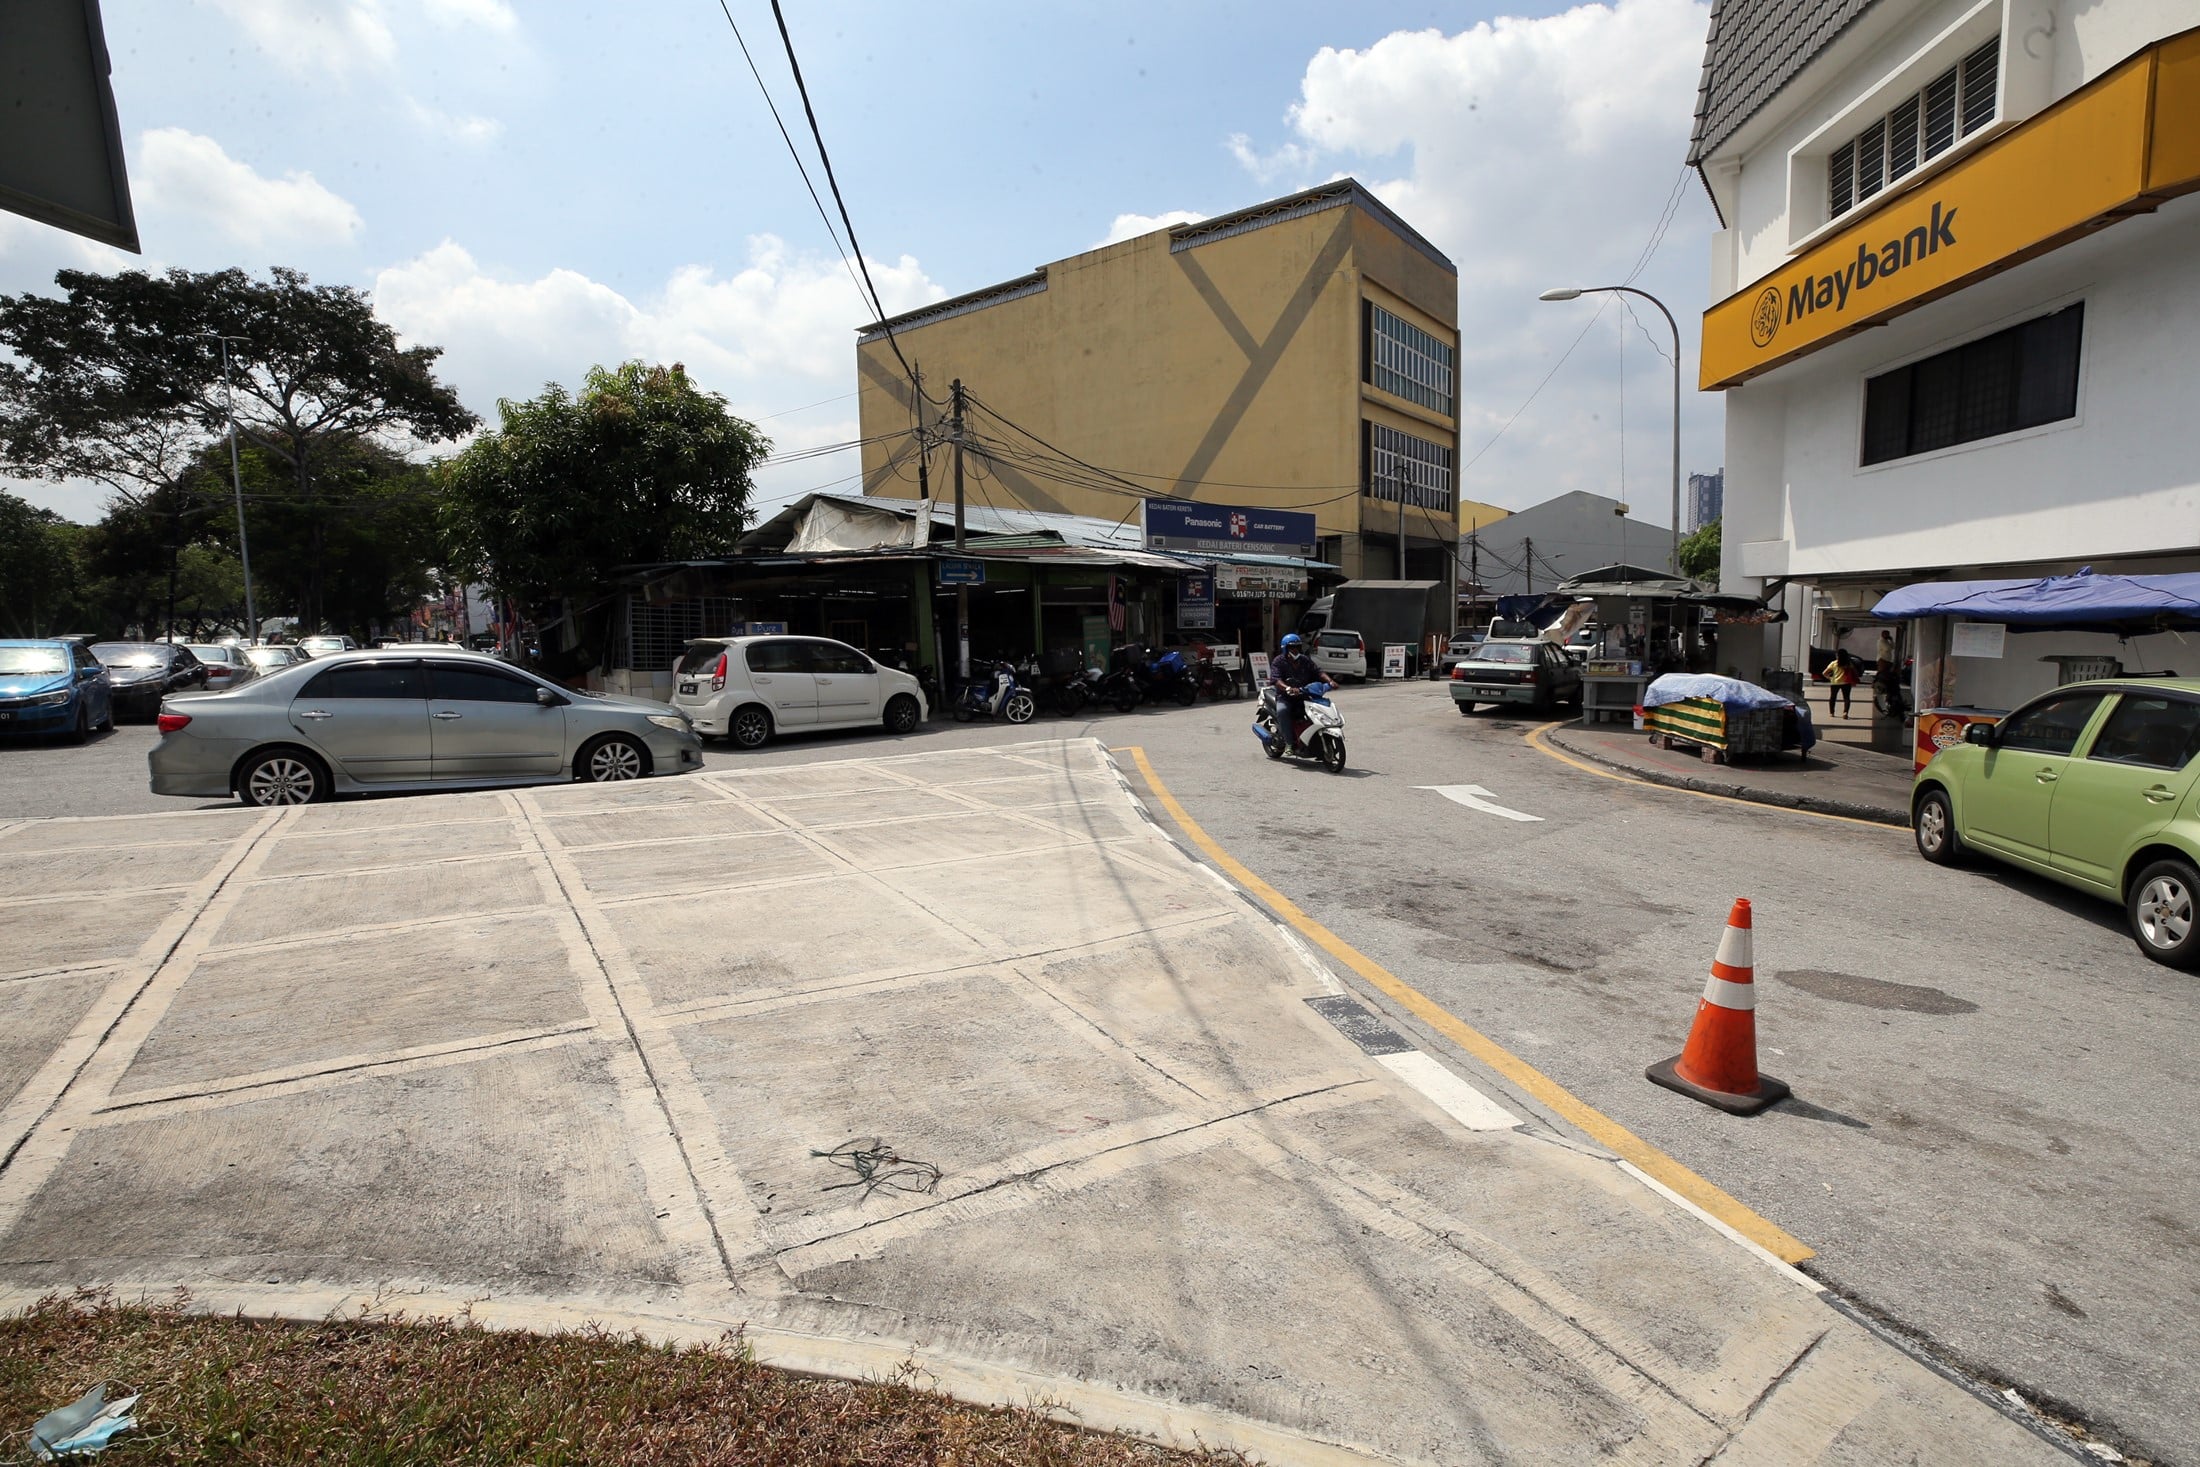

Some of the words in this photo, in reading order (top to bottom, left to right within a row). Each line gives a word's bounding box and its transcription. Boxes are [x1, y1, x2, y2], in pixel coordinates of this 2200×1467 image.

[1786, 201, 1958, 325] Maybank
[1184, 516, 1223, 528] Panasonic
[1264, 523, 1285, 531] BATTERY
[1197, 540, 1218, 549] KEDAI
[1220, 541, 1242, 551] BATERI
[1243, 542, 1275, 553] CENSONIC
